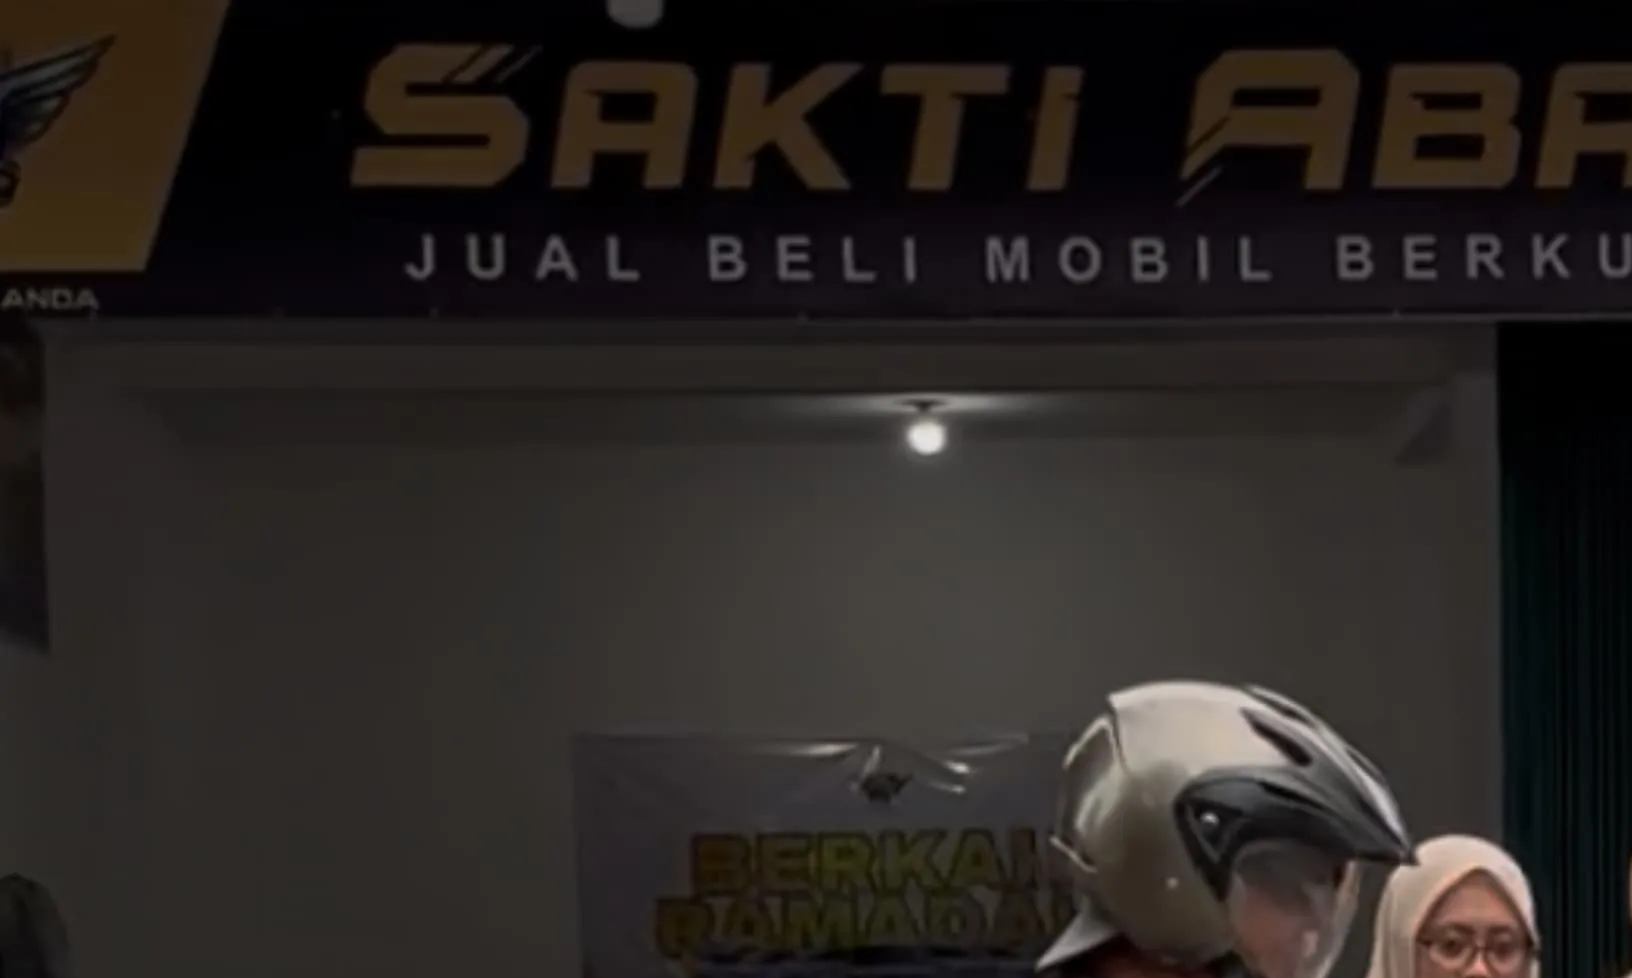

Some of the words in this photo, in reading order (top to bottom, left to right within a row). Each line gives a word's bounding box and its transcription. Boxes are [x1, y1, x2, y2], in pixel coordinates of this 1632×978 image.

[349, 41, 1086, 192] SAKTI
[403, 232, 641, 282] JUAL
[706, 234, 919, 283] BELI
[984, 235, 1274, 284] MOBIL
[0, 286, 100, 311] ANDA
